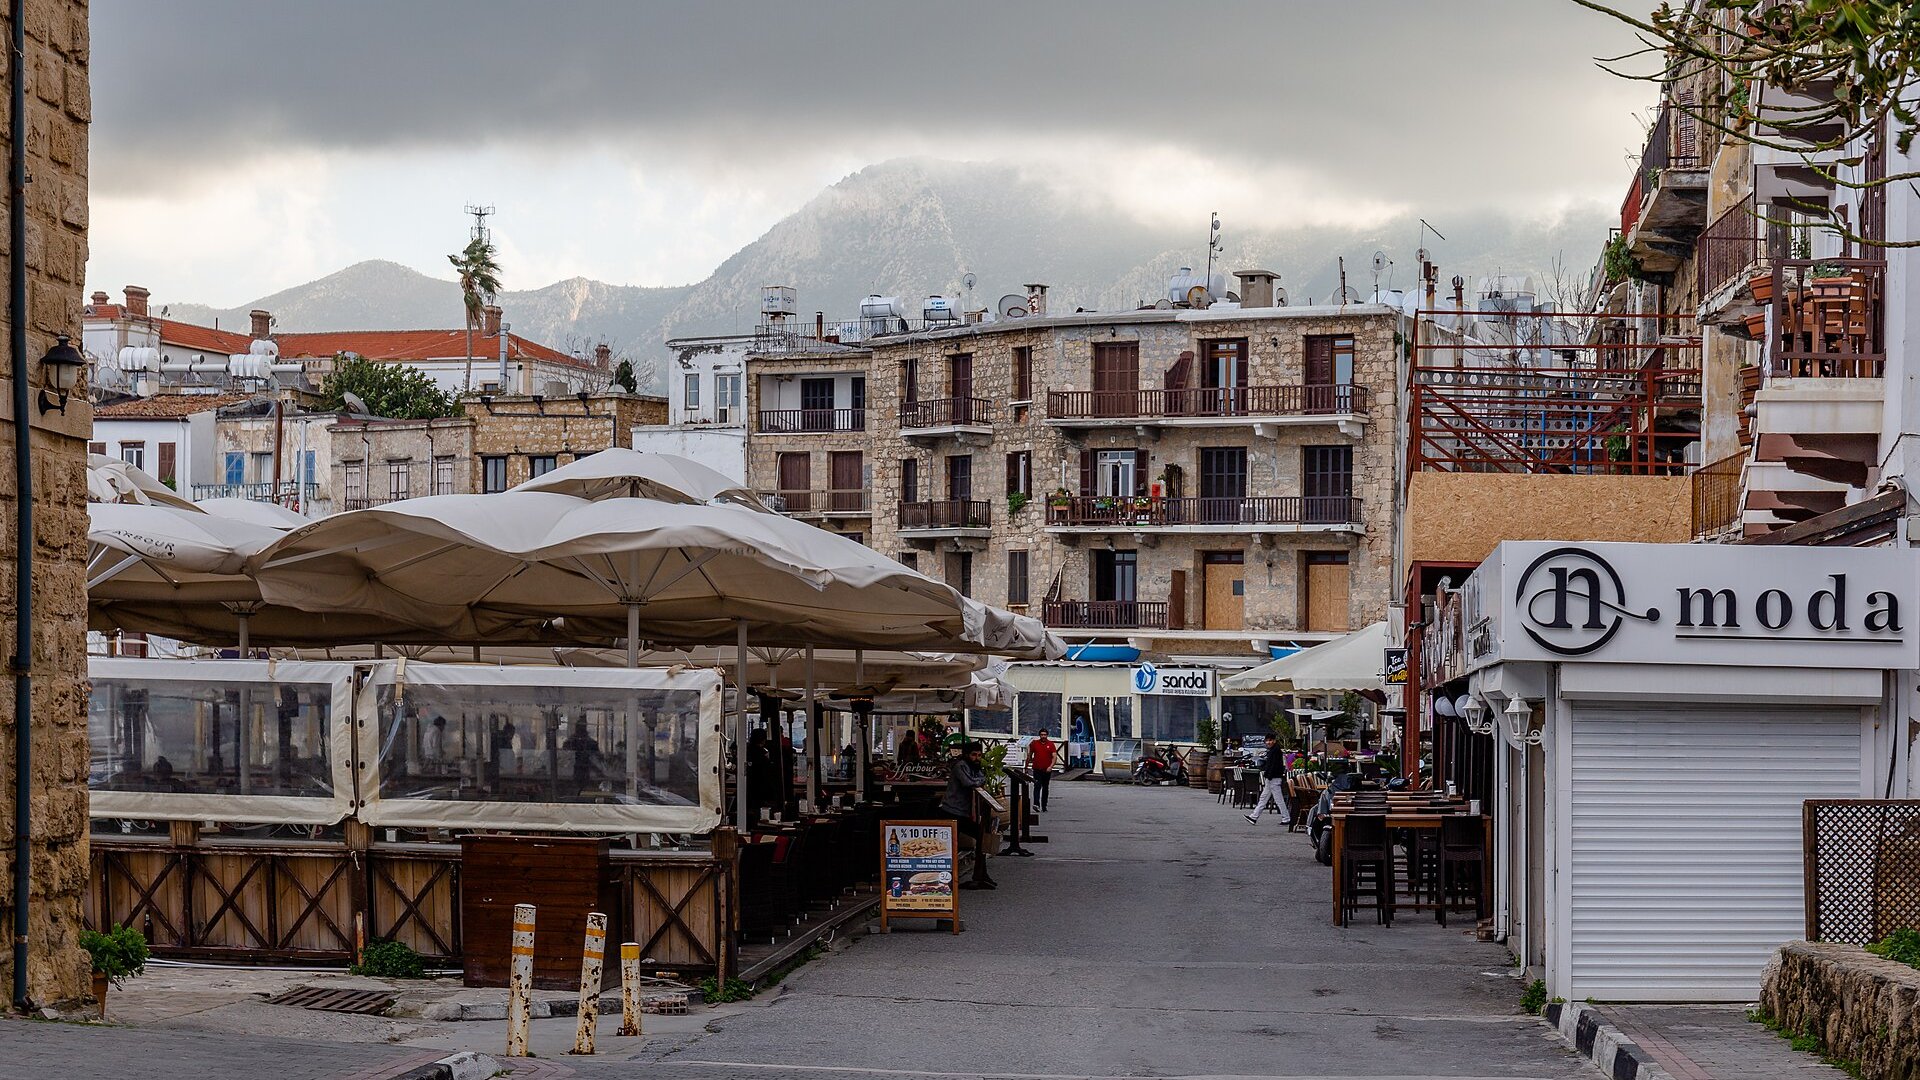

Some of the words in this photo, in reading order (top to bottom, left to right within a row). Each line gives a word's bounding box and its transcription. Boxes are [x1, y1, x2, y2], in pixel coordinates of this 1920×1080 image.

[1675, 573, 1904, 633] moda
[1162, 671, 1207, 689] sandal
[909, 828, 919, 838] 10
[922, 828, 938, 838] OFF
